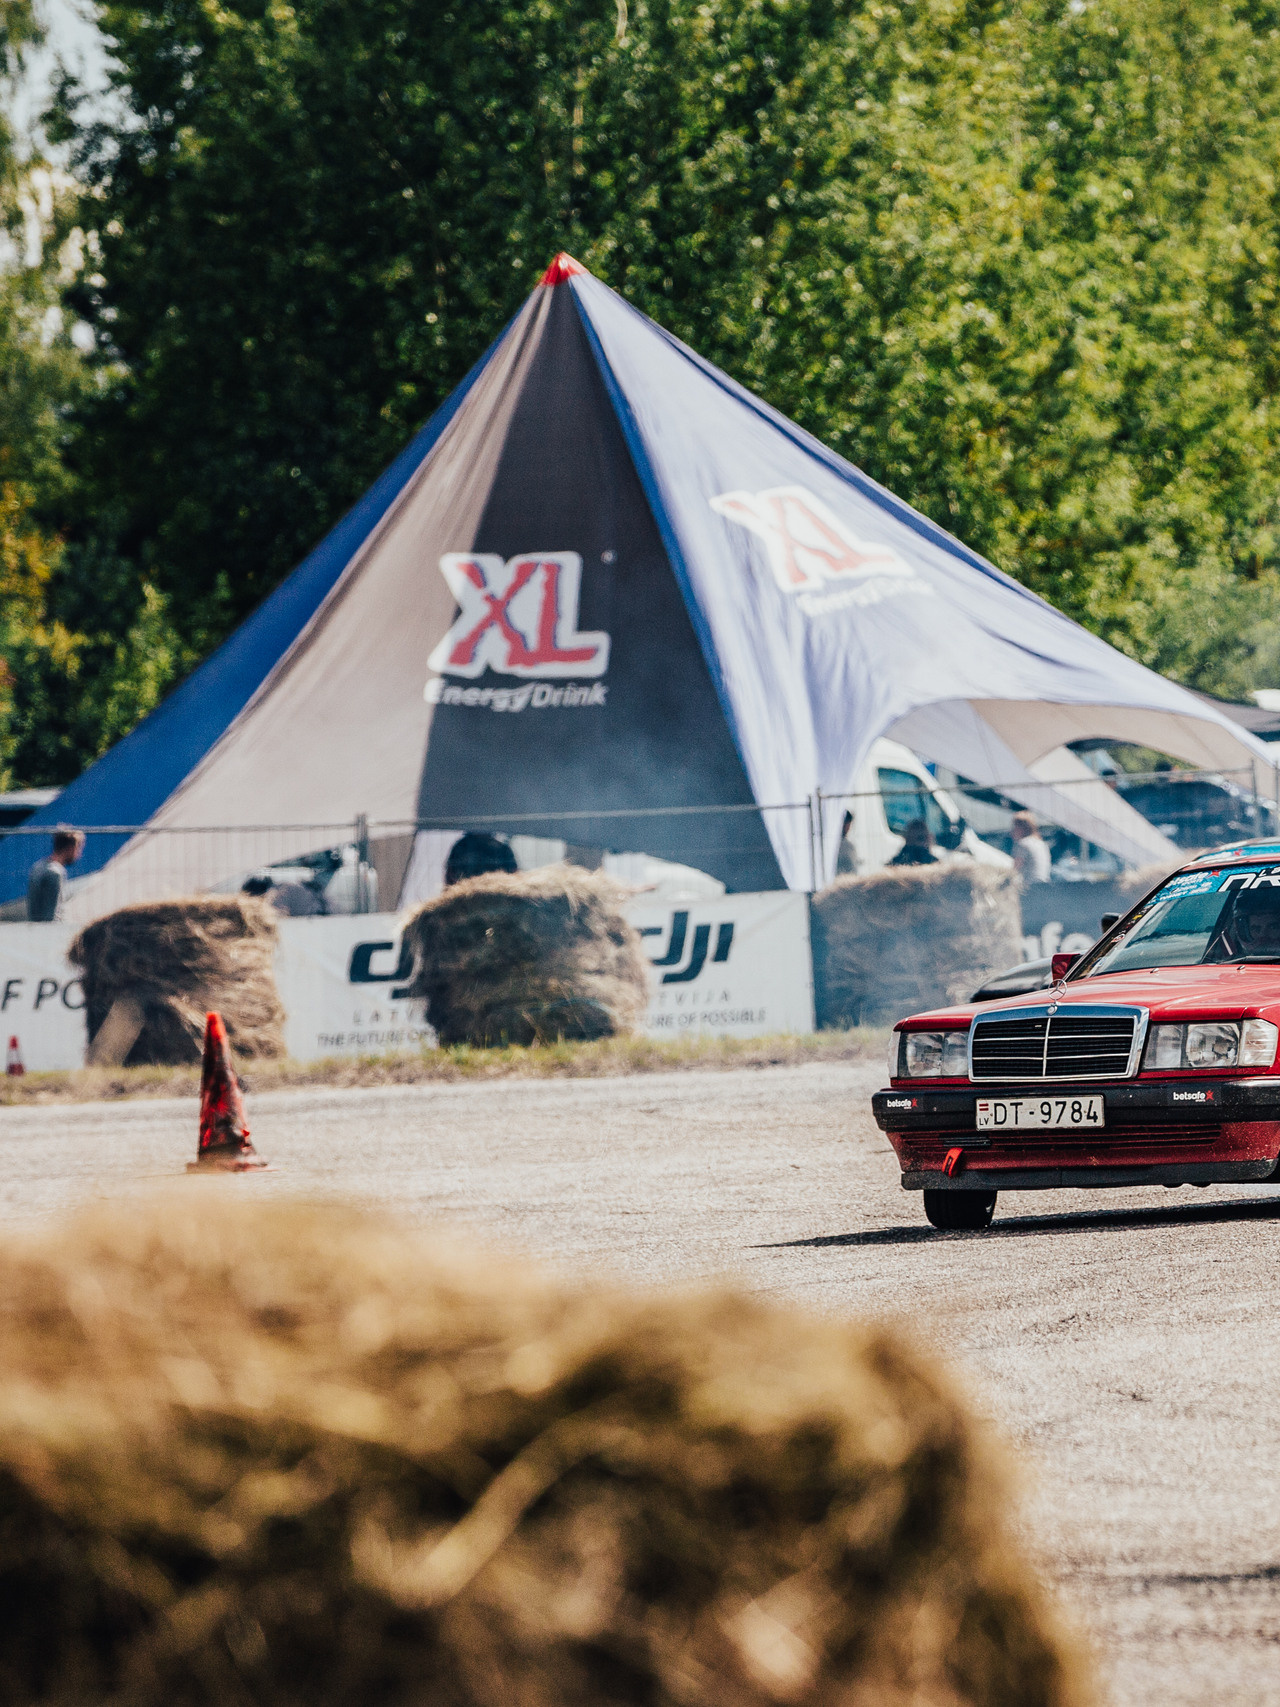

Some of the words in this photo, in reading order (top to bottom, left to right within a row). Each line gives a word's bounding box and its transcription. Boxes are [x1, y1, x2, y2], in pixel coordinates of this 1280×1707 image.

[427, 551, 611, 678] XL
[1173, 1091, 1206, 1101] betsafe
[886, 1098, 912, 1108] betsafe
[978, 1118, 990, 1126] LV
